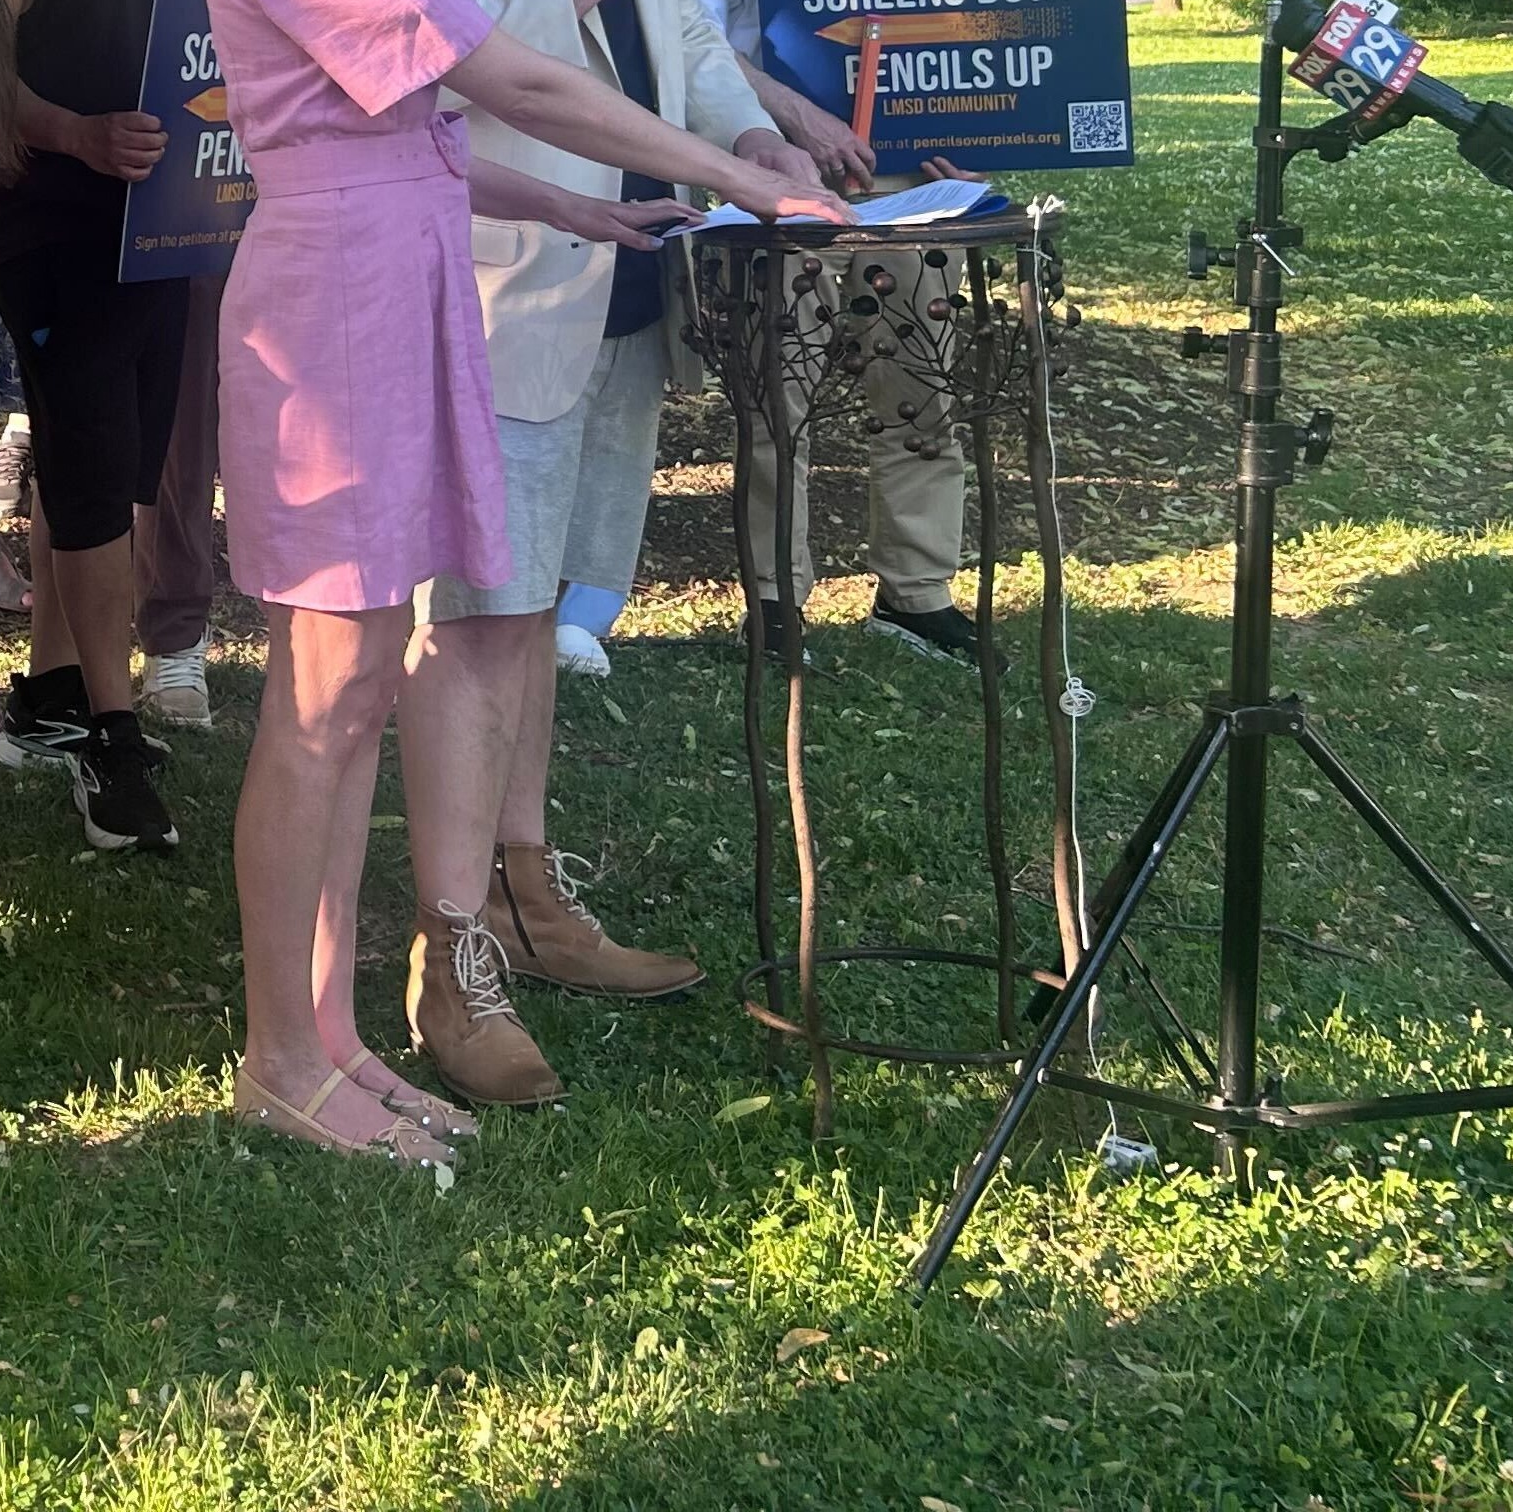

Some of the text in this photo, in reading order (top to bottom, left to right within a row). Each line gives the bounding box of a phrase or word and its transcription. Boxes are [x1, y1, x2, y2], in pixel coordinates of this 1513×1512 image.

[1322, 8, 1363, 51] FOX
[1005, 45, 1053, 89] UP
[1295, 52, 1332, 83] FOX
[1352, 25, 1402, 80] 29
[1391, 47, 1423, 89] NEWS
[1323, 68, 1372, 110] 29
[883, 94, 1018, 117] LMSD COMMUNITY
[1362, 90, 1392, 120] NEWS
[895, 138, 910, 150] at
[913, 132, 1061, 152] pencilsoverpixels.org
[216, 182, 245, 203] LMSD
[135, 235, 158, 252] Sign
[160, 234, 178, 248] the
[178, 231, 217, 247] petition
